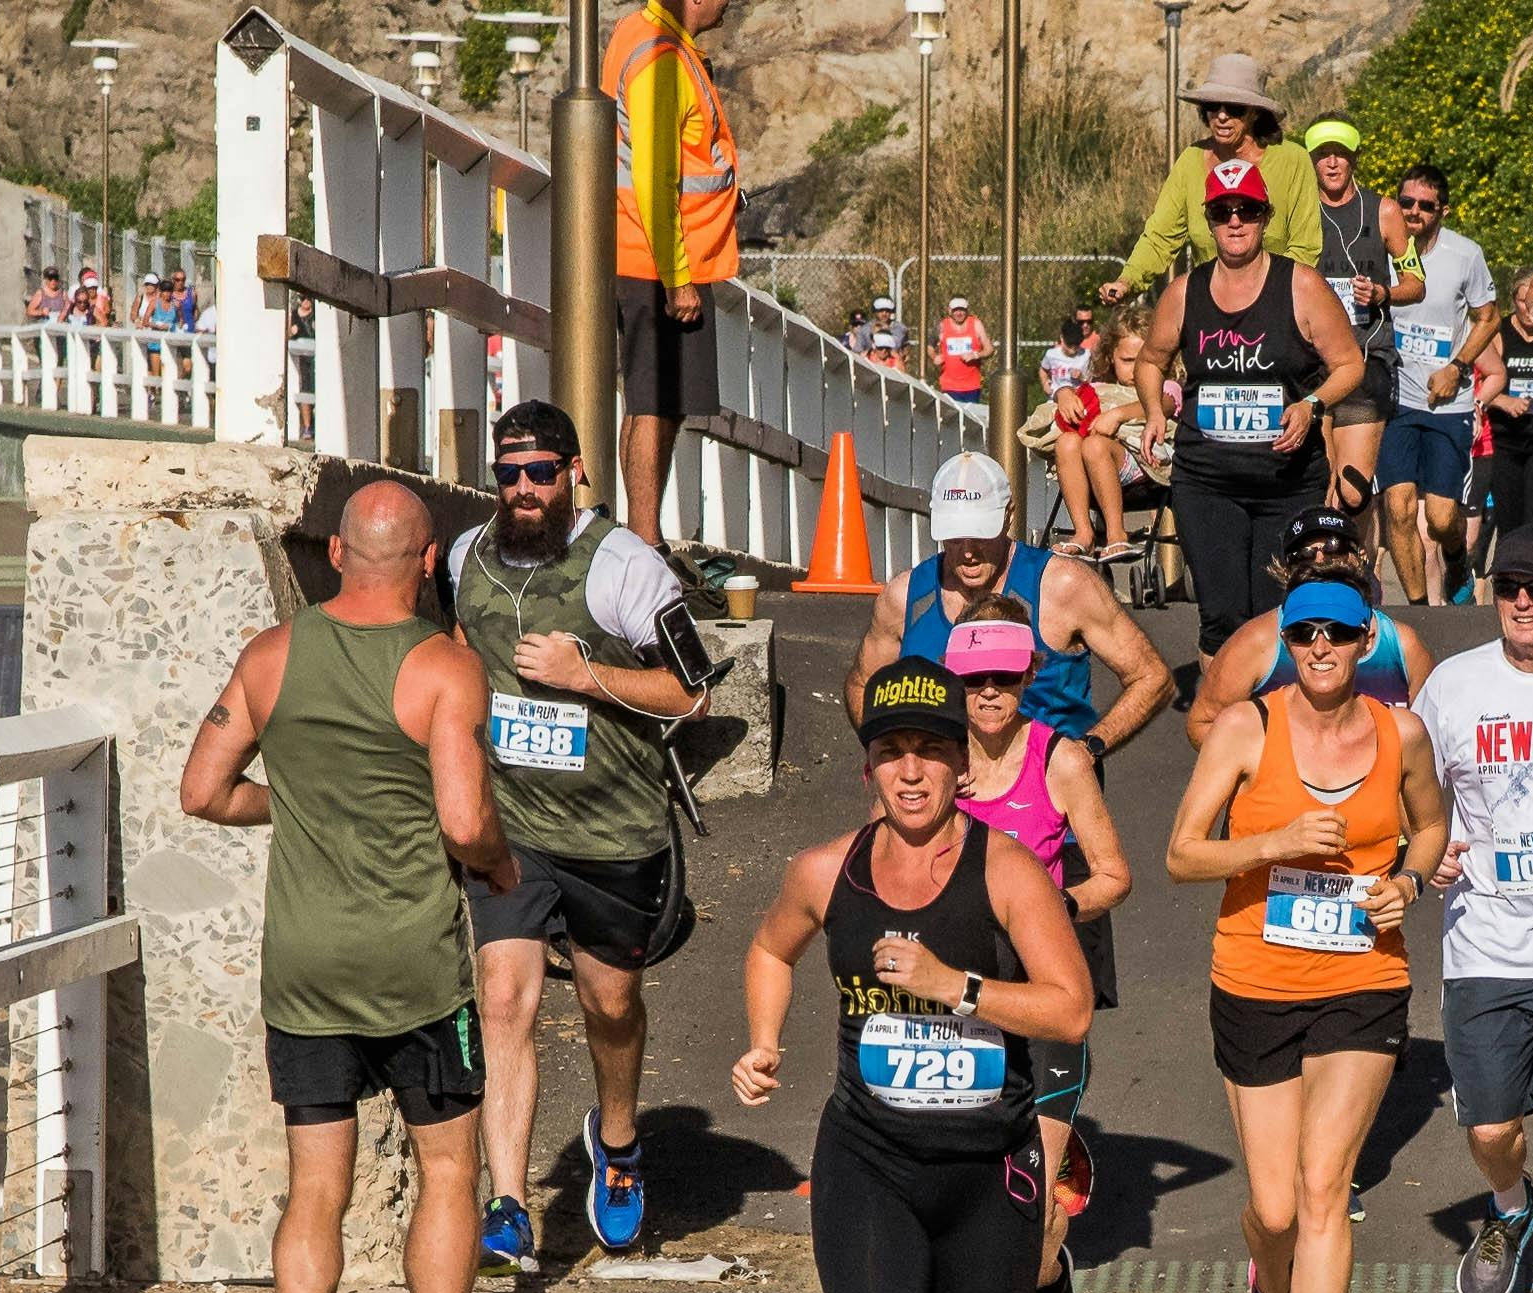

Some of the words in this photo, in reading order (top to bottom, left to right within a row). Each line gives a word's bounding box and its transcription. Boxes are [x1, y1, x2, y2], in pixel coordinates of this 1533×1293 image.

[1199, 328, 1266, 355] run
[1401, 335, 1438, 356] 990
[1206, 343, 1275, 374] wild
[1214, 407, 1270, 431] 1175
[943, 489, 981, 500] HERALD
[1319, 516, 1344, 527] RSPT
[873, 676, 947, 707] highlite
[499, 720, 573, 756] 1298
[1291, 898, 1353, 935] 661
[887, 1048, 975, 1089] 729
